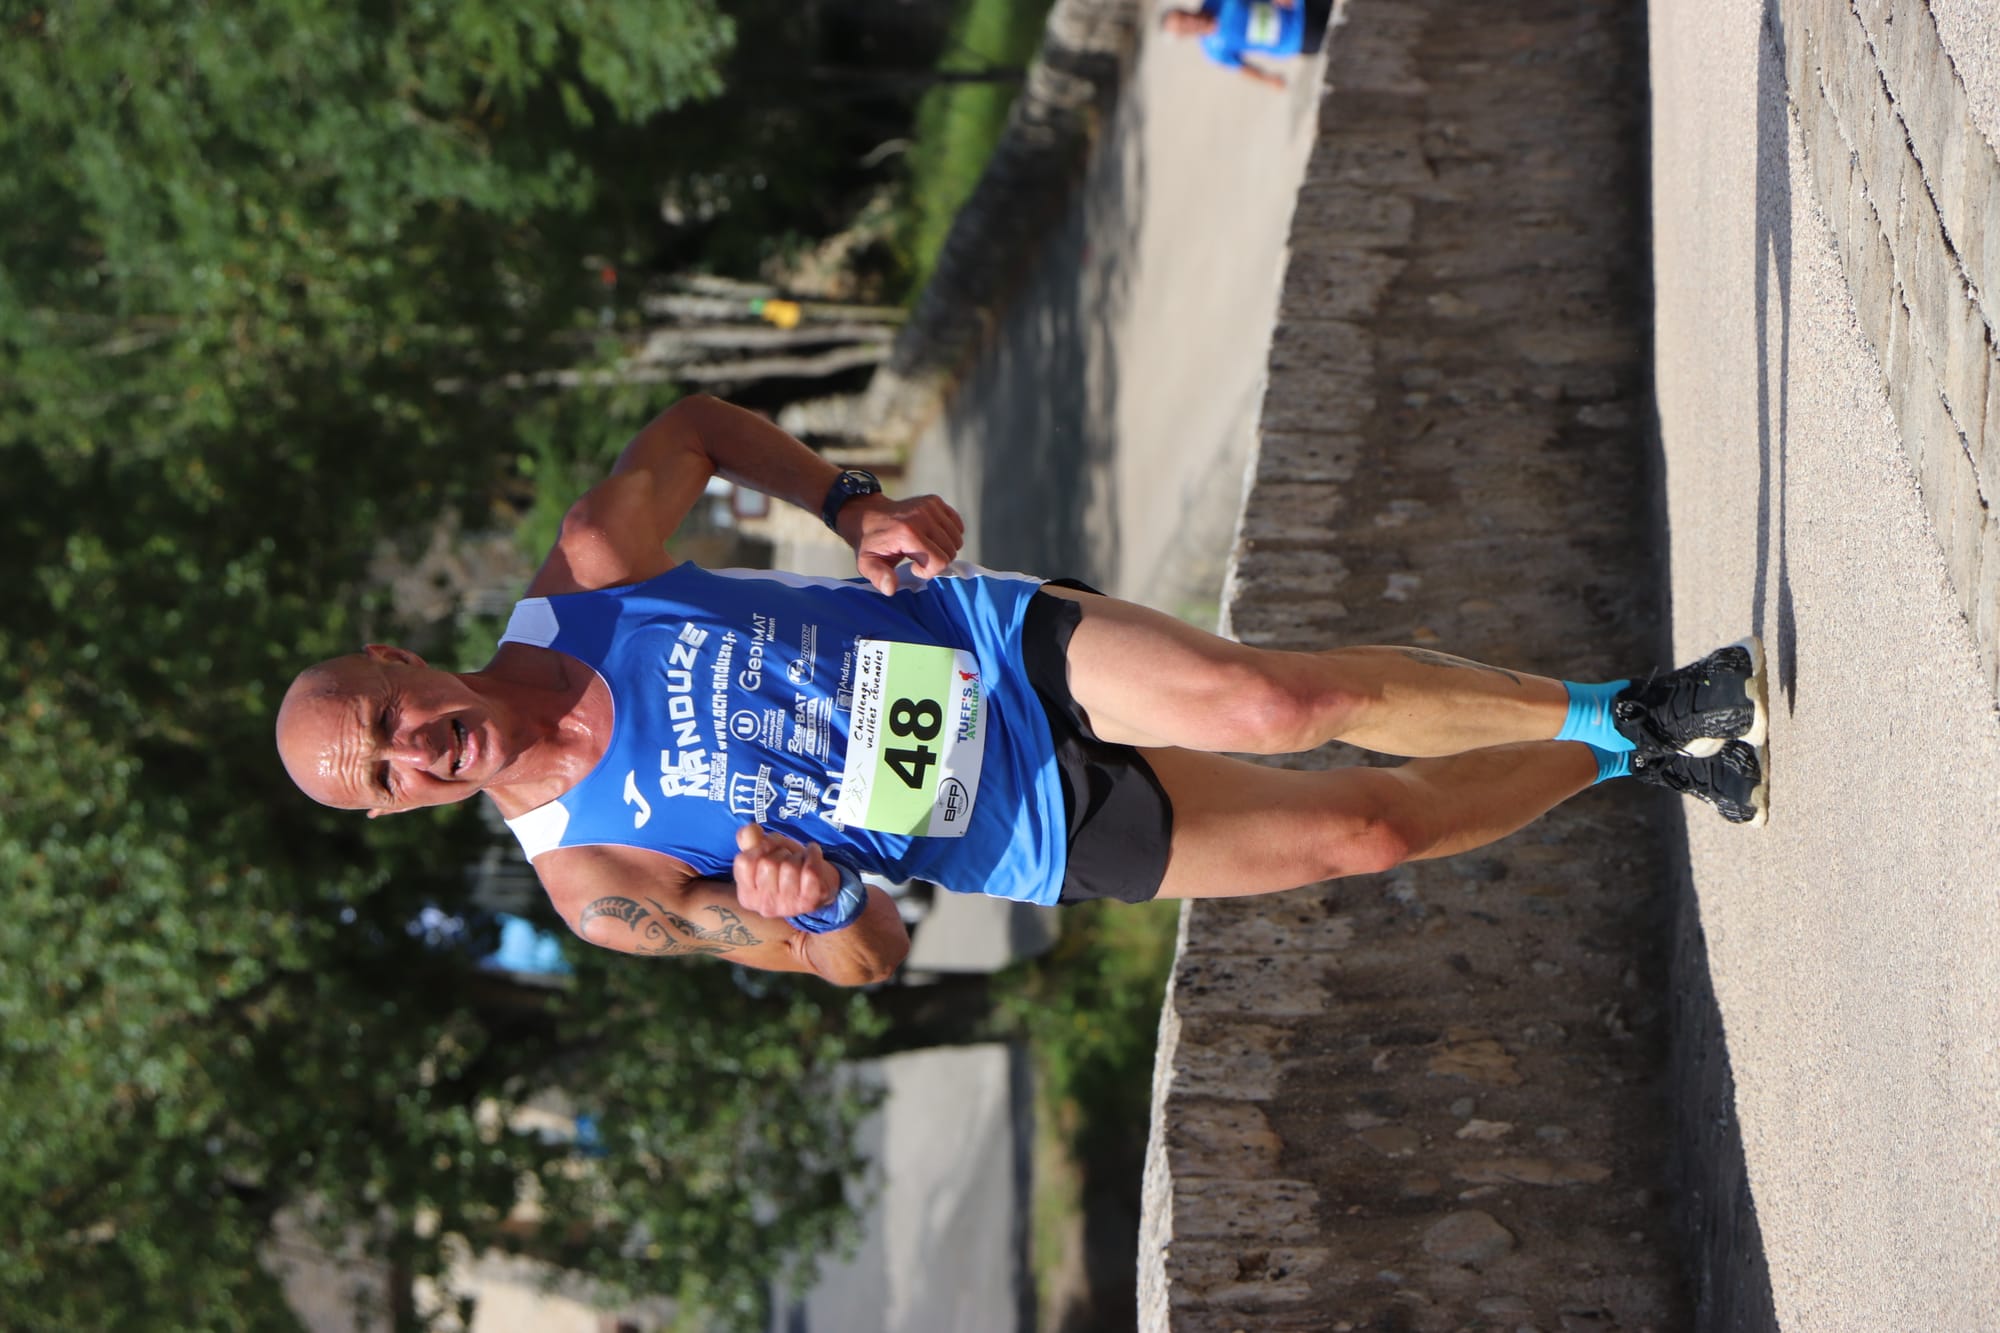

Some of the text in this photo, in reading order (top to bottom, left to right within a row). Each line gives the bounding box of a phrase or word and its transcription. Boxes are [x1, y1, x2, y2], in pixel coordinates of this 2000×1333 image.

[711, 632, 736, 750] www.acn-anduze.fr
[853, 655, 871, 741] Challenge des
[956, 687, 973, 743] TUFF'S
[966, 682, 980, 740] Aventure
[738, 717, 753, 734] U
[866, 707, 877, 748] vallées
[884, 698, 942, 790] 48
[944, 784, 960, 822] BFP
